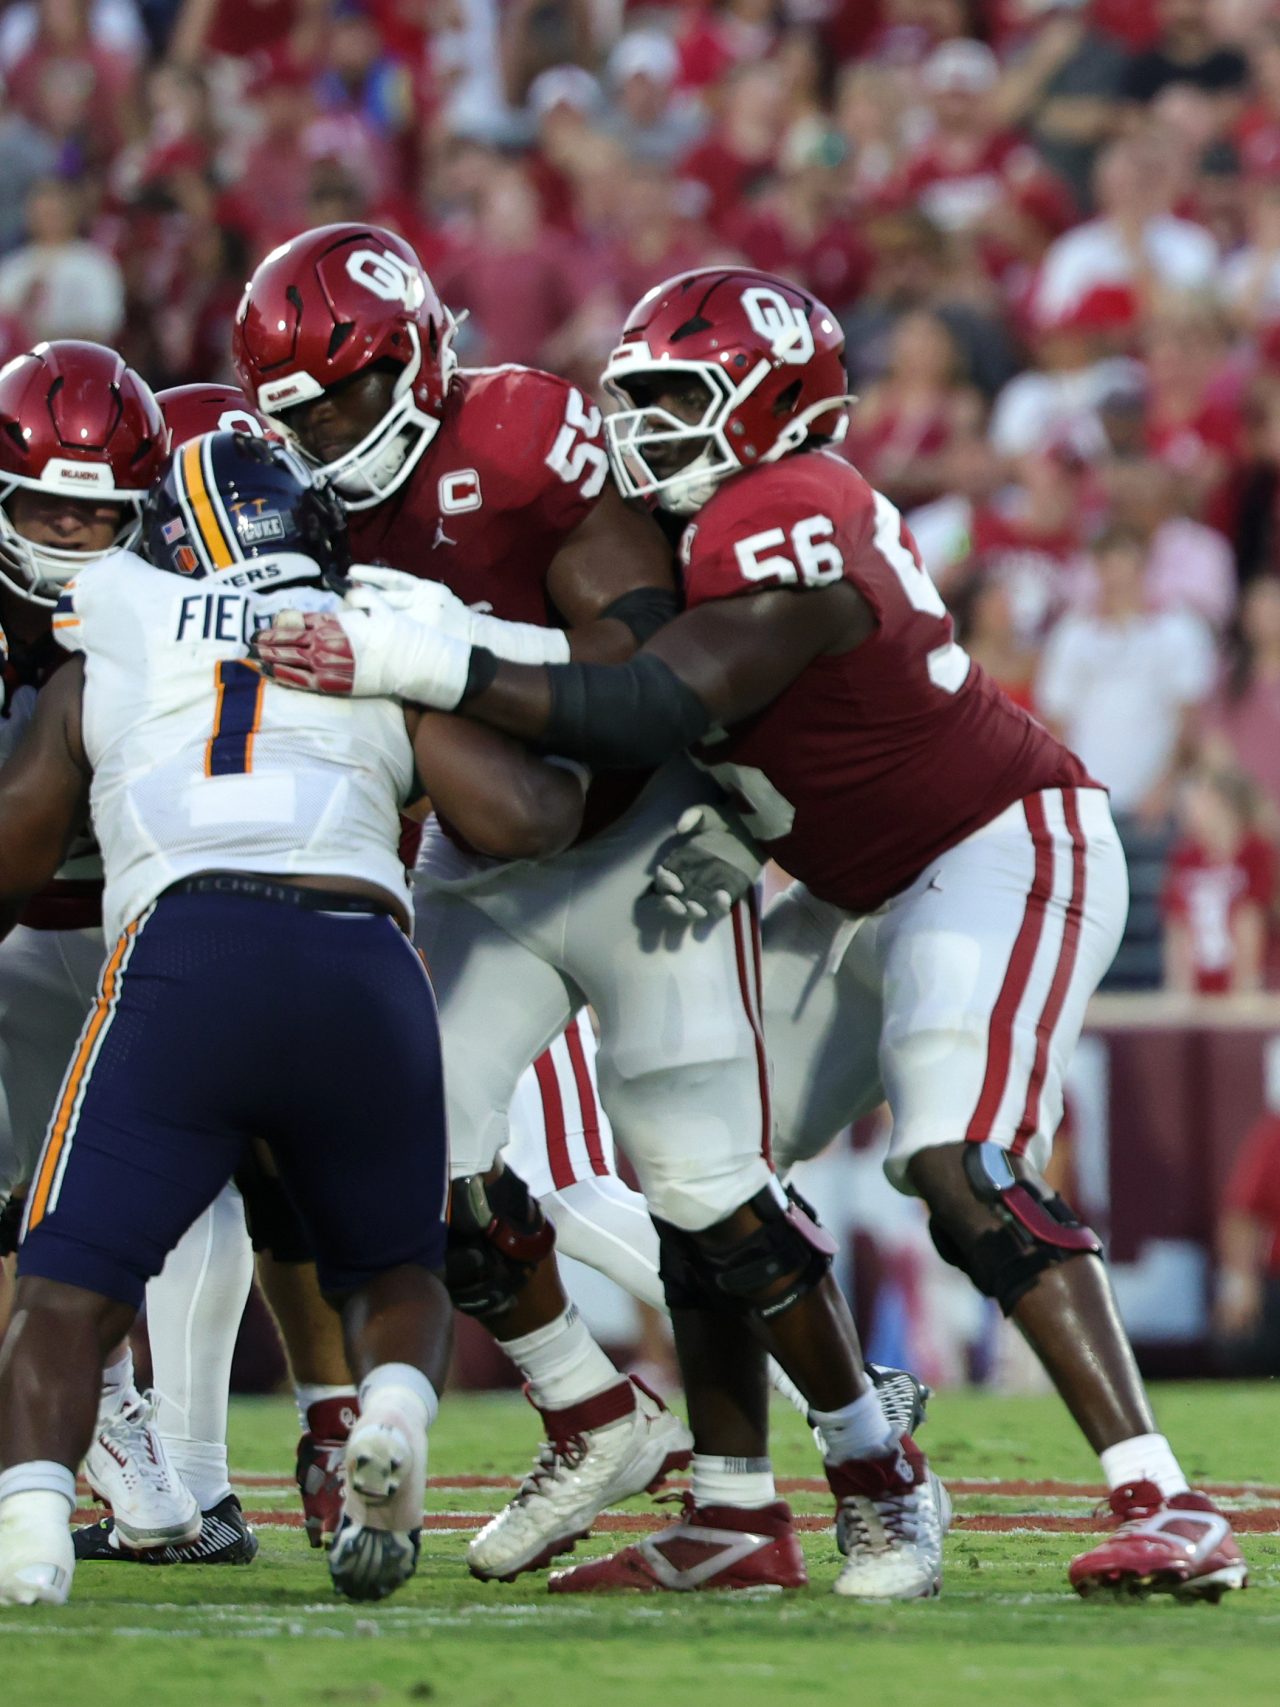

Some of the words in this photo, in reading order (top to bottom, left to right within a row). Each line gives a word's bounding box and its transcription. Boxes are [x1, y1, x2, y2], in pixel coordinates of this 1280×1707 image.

[345, 249, 425, 312] OU
[741, 287, 815, 364] OU
[544, 386, 609, 498] 55
[442, 472, 480, 512] C
[734, 514, 844, 588] 56
[205, 659, 266, 778] 1
